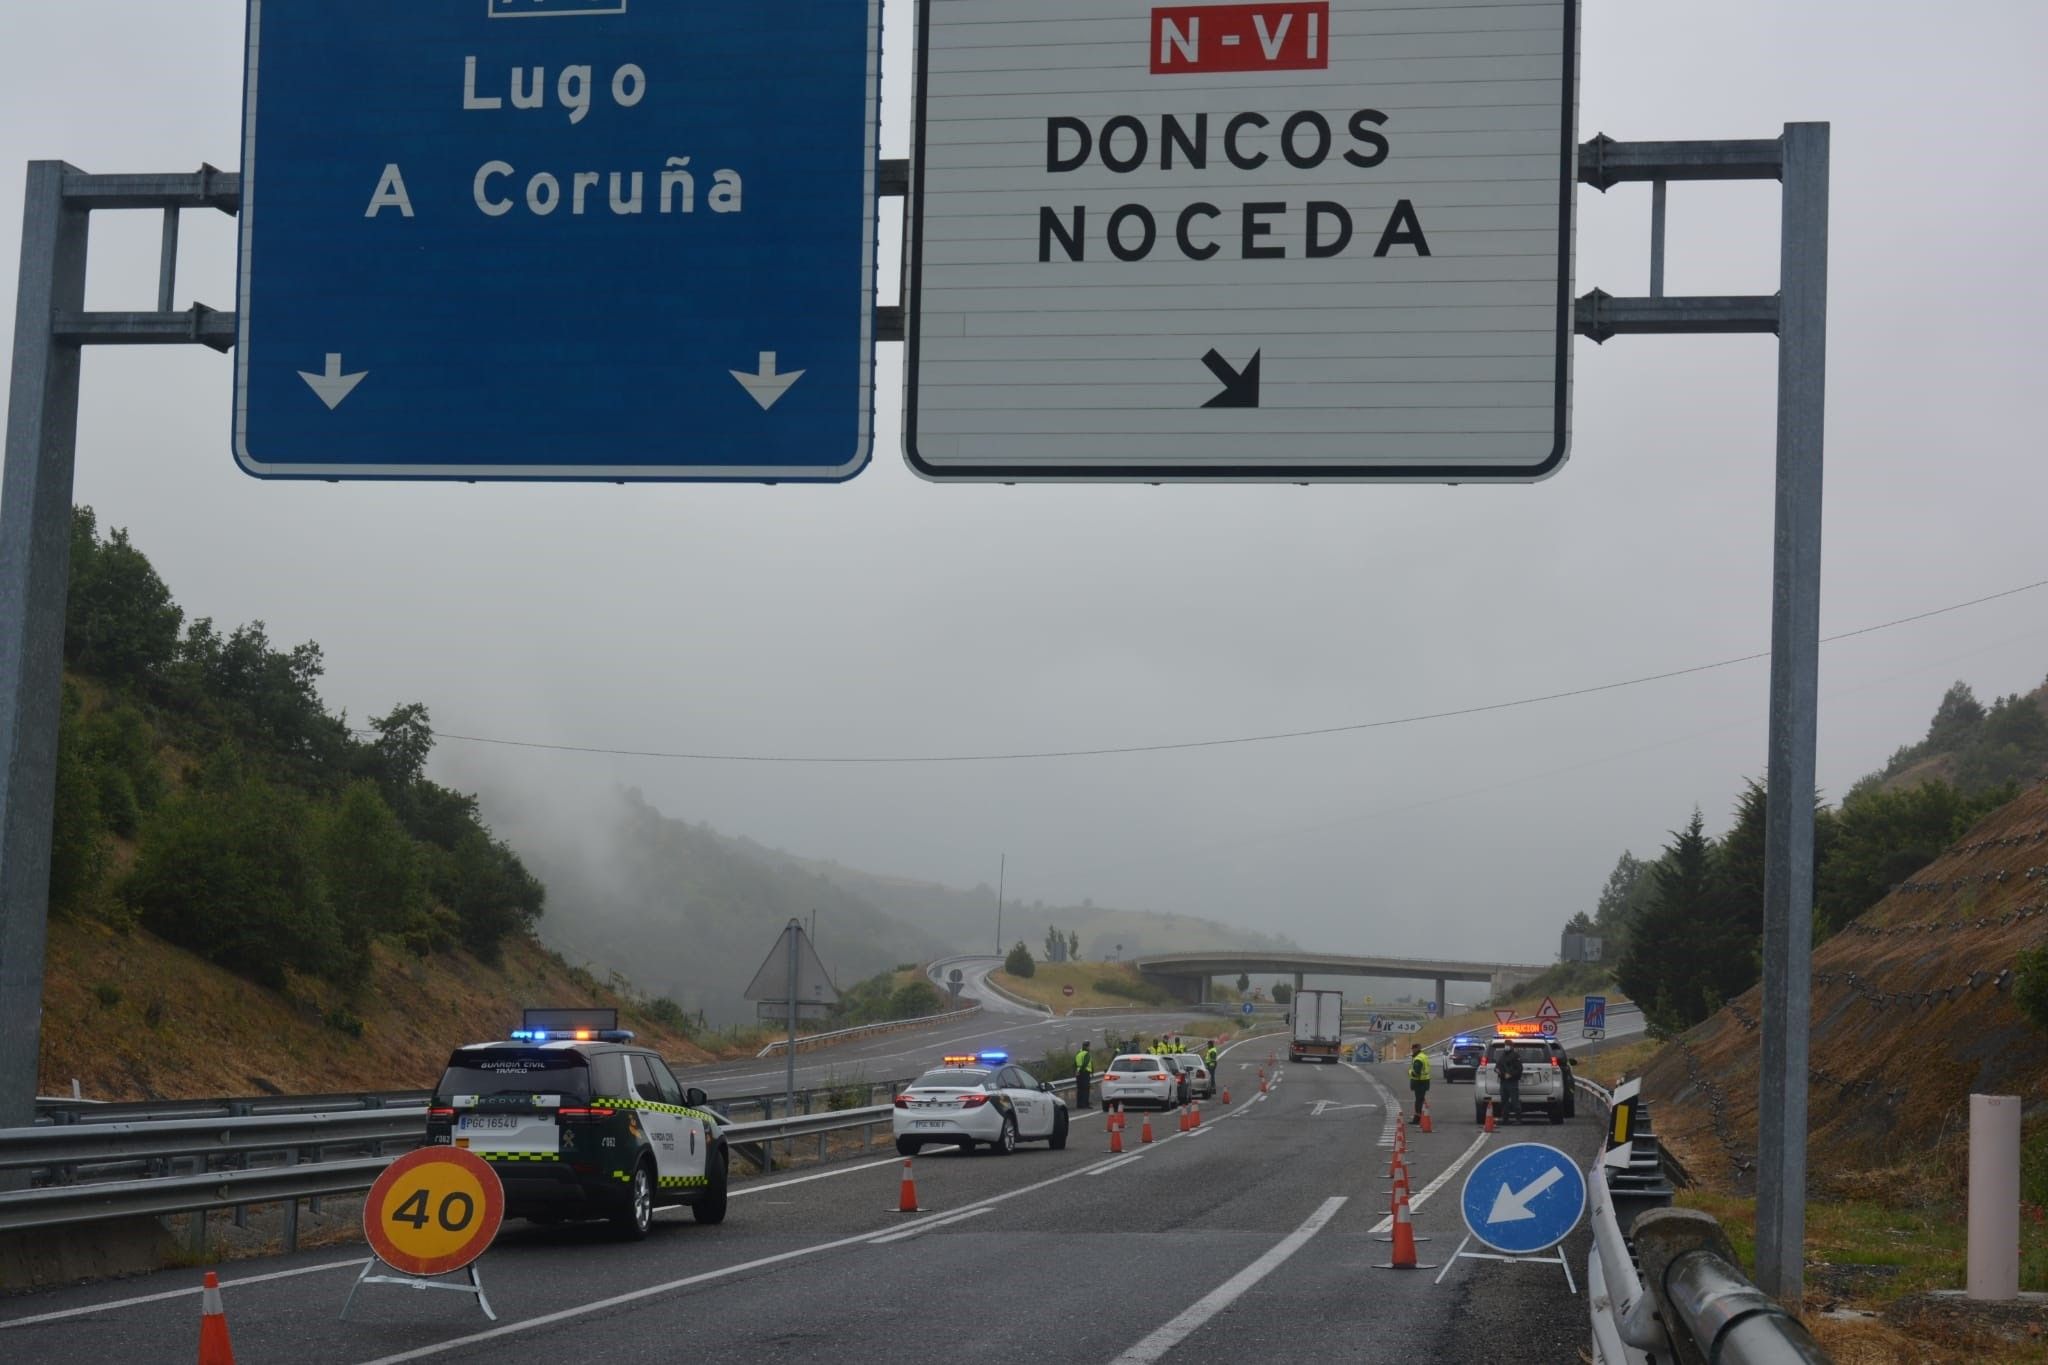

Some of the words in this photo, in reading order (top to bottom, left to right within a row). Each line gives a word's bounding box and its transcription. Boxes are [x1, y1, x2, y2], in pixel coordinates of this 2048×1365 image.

[1161, 13, 1318, 64] N-VI
[463, 55, 646, 124] Lugo
[1046, 108, 1389, 174] DONCOS
[364, 163, 415, 218] A
[473, 156, 742, 216] Coruña
[1038, 199, 1432, 263] NOCEDA
[1398, 1023, 1416, 1031] 438
[1543, 1024, 1554, 1032] 50
[467, 1119, 484, 1128] PGC
[391, 1188, 475, 1232] 40
